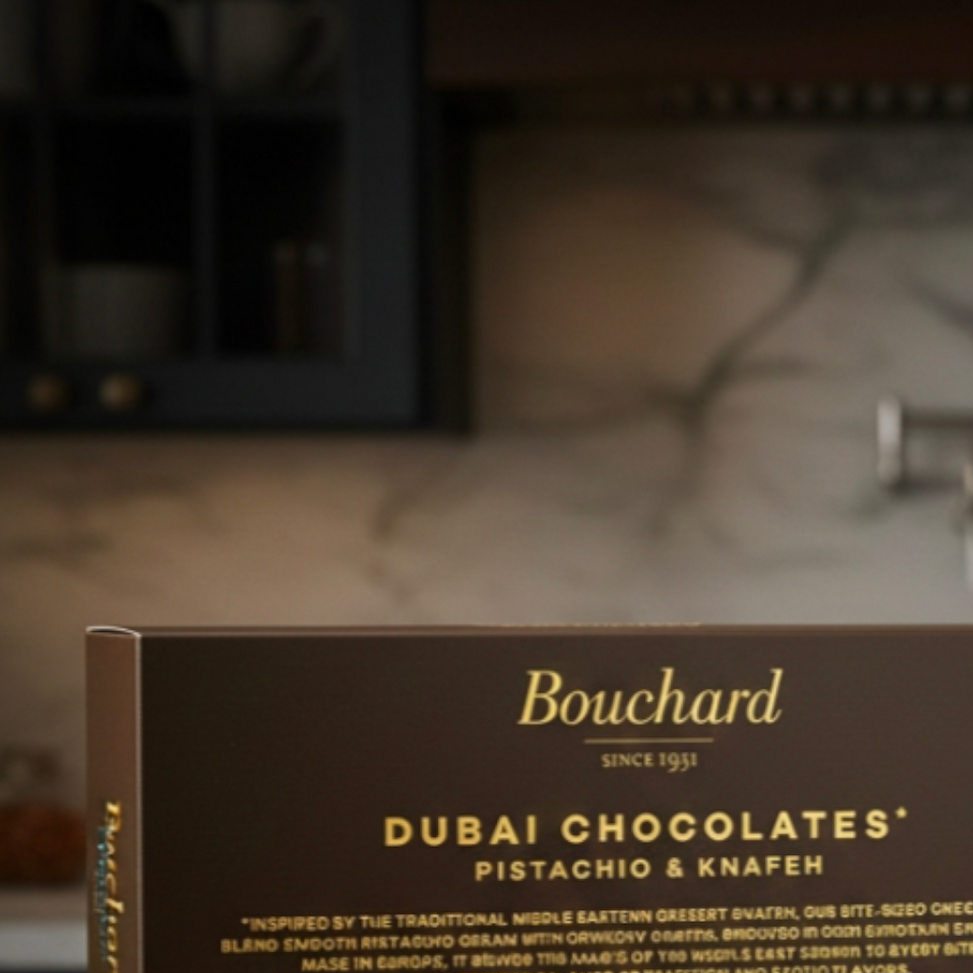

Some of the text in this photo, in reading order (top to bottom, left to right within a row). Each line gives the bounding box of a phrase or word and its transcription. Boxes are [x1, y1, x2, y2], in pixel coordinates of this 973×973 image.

[517, 667, 784, 727] Bouchard
[601, 751, 698, 773] SINCE 1931
[384, 815, 538, 847] DUBAI
[474, 855, 825, 882] PISTACHIO & KNAFEH
